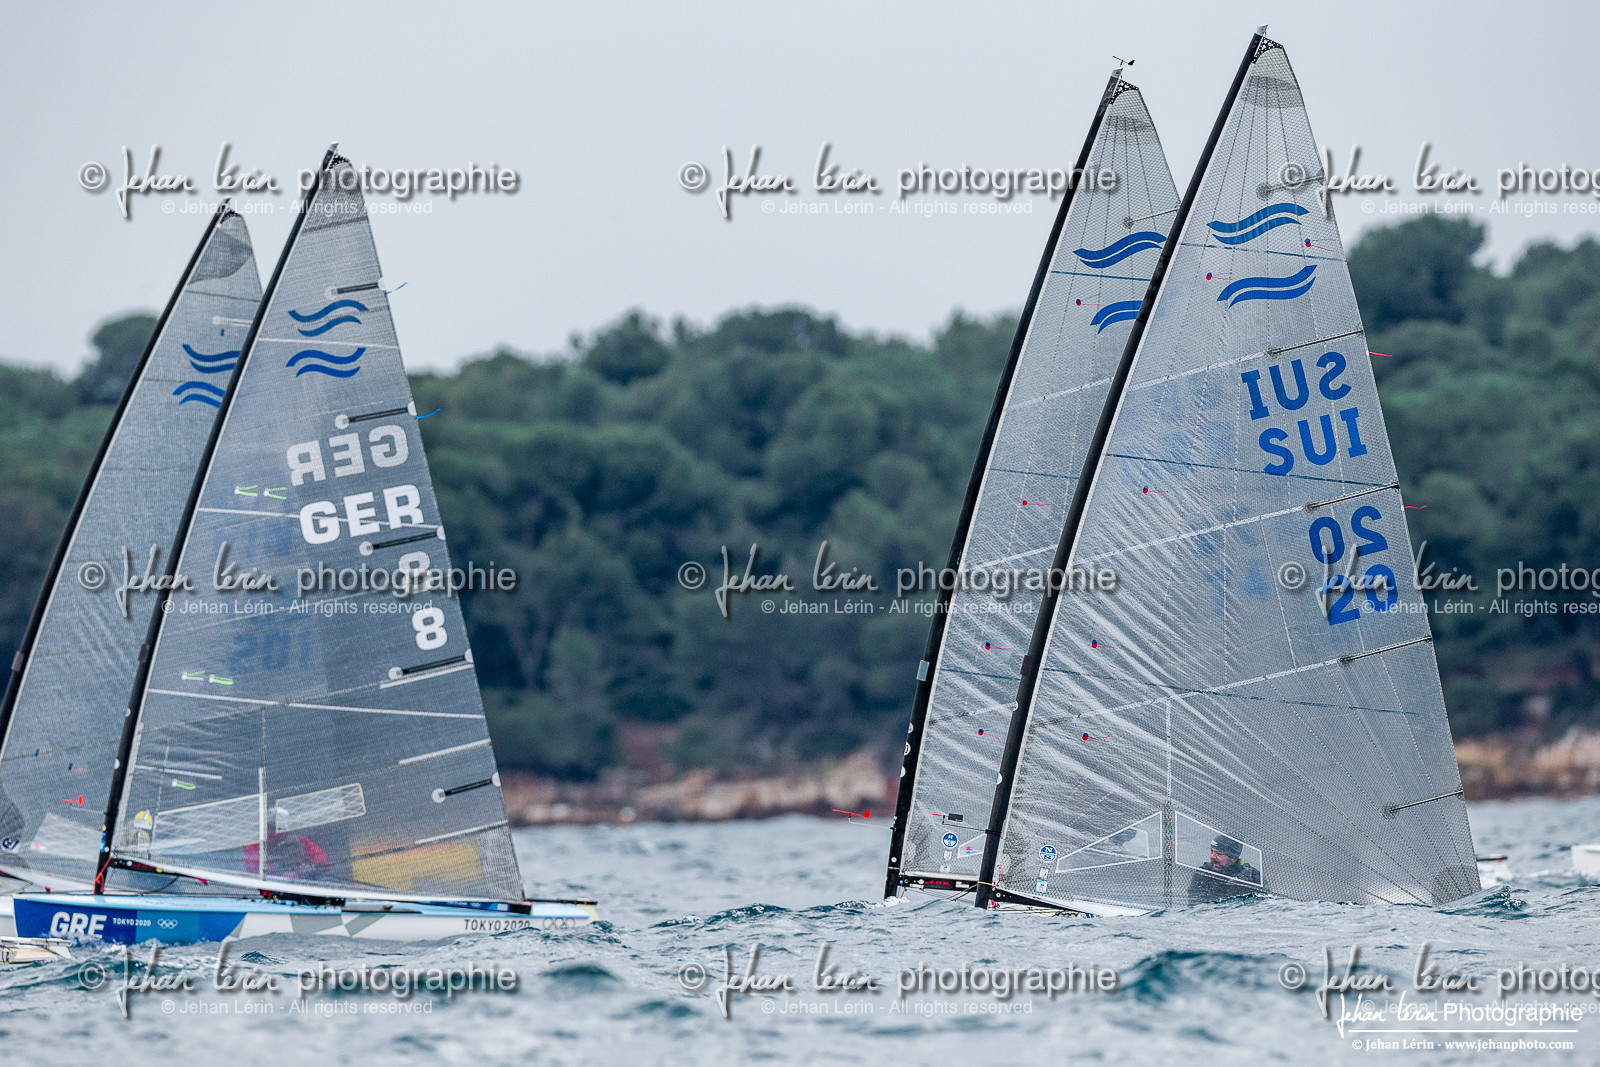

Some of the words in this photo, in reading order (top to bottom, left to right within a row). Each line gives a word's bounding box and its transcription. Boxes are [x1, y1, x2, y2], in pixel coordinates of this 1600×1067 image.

[1258, 407, 1368, 476] SUI
[300, 484, 424, 545] GER
[411, 607, 448, 650] 8
[50, 911, 107, 939] GRE
[112, 917, 135, 926] TOKYO
[135, 918, 151, 927] 2020
[464, 919, 500, 931] TOKYO
